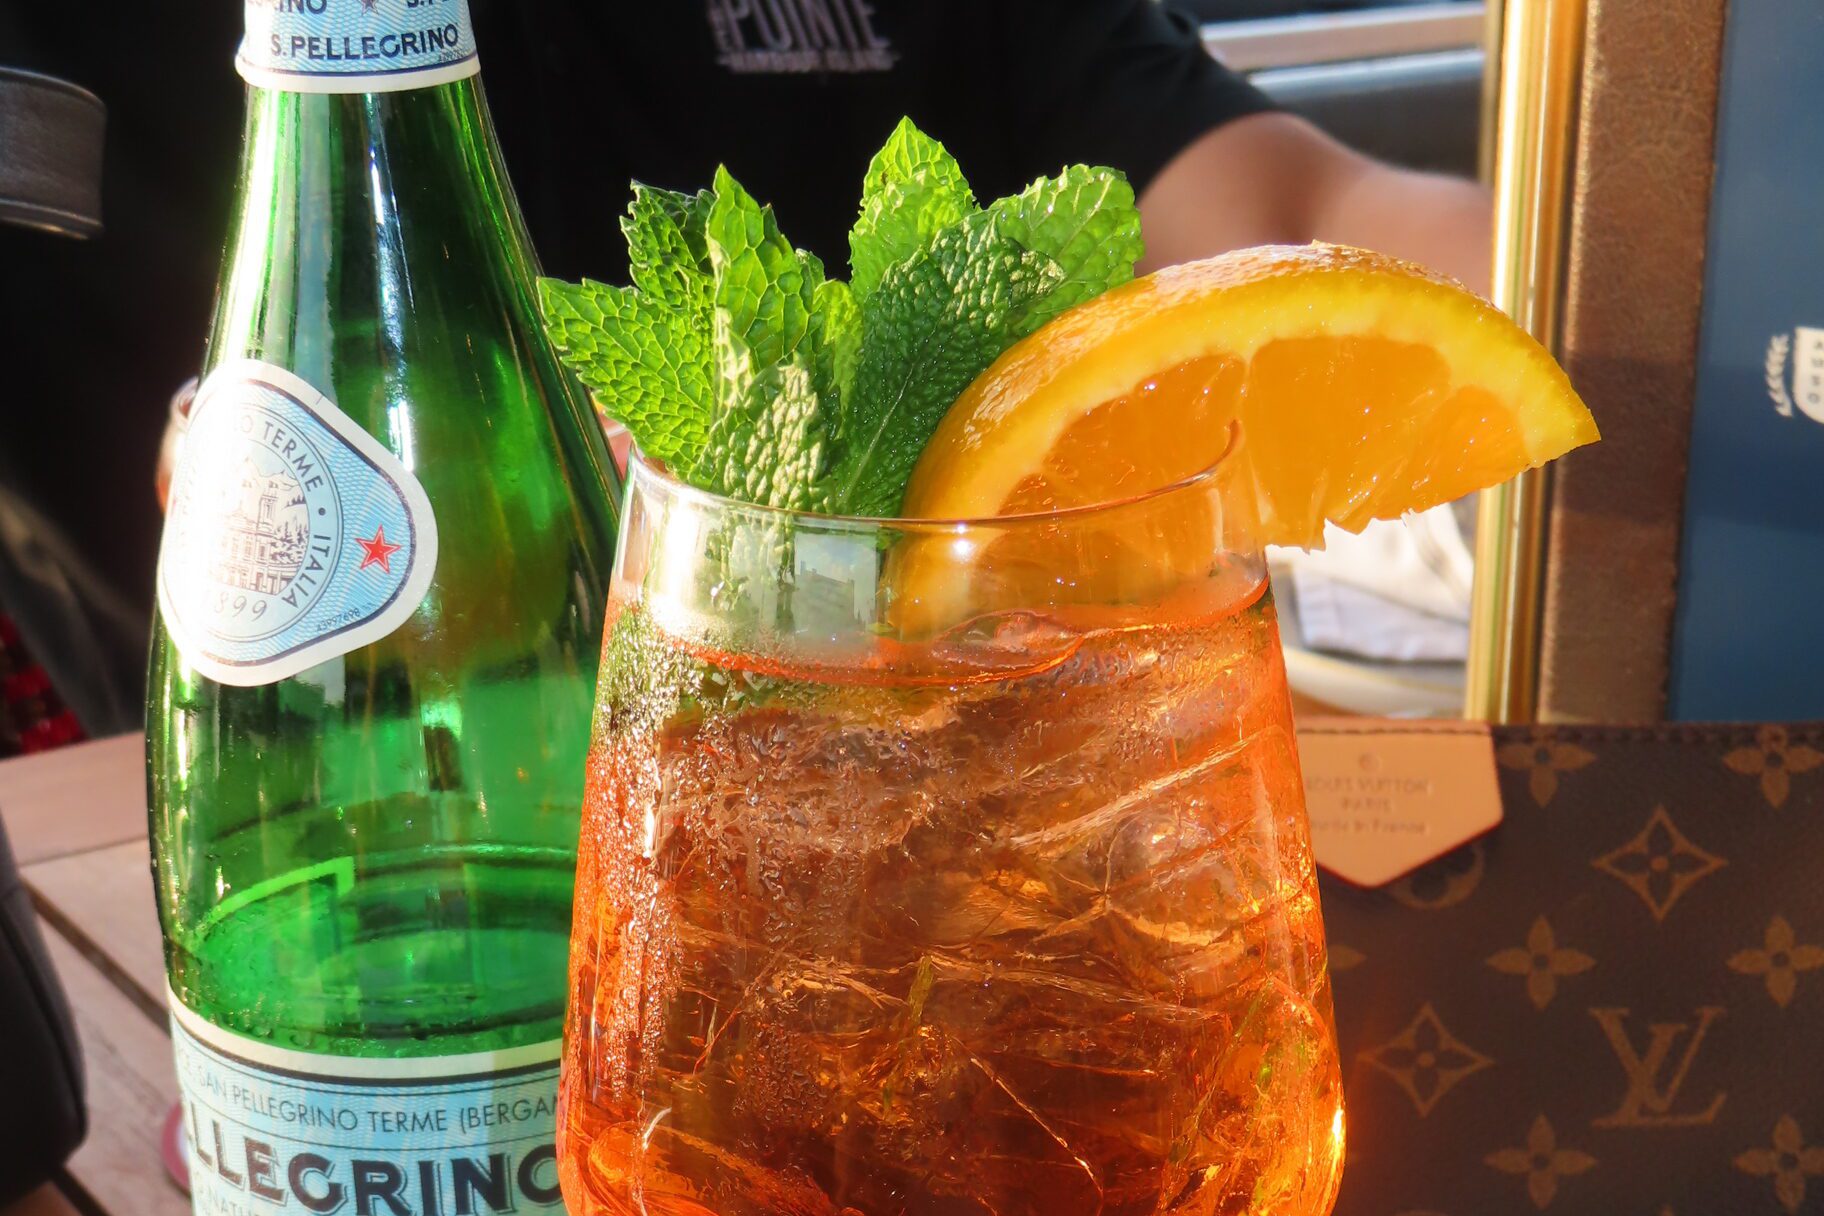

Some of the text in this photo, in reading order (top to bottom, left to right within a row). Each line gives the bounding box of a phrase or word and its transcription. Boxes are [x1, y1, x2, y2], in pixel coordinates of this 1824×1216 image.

[271, 23, 459, 60] S.PELLEGRINO
[263, 419, 332, 609] TERME ITALIA
[232, 1084, 358, 1131] PELLEGRINO
[367, 1109, 447, 1133] TERME
